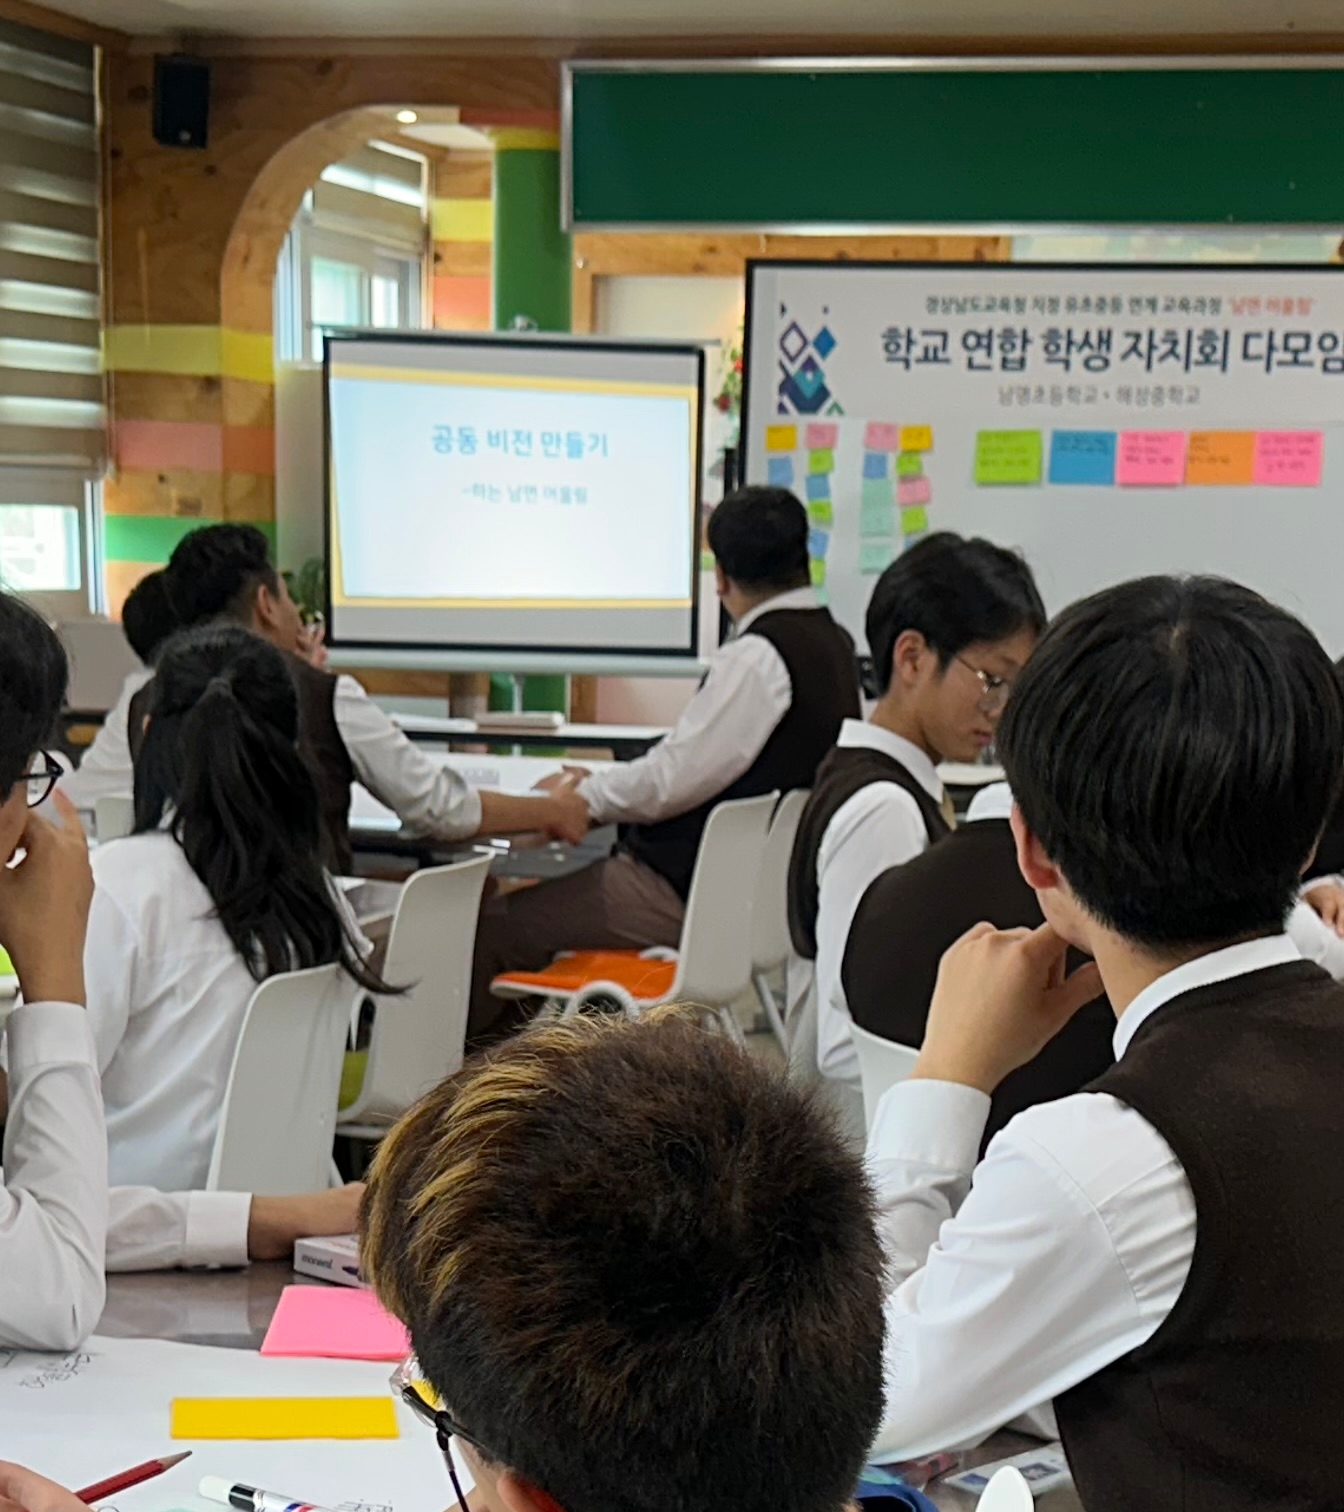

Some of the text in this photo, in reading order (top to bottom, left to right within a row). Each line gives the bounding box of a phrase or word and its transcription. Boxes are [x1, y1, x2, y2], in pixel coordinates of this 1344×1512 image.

[1162, 297, 1222, 315] 교육과정
[879, 327, 951, 373] 학교
[961, 328, 1033, 371] 연합
[1041, 327, 1113, 373] 학생
[1120, 328, 1231, 373] 자치회
[431, 424, 609, 459] 공동 비전 만들기
